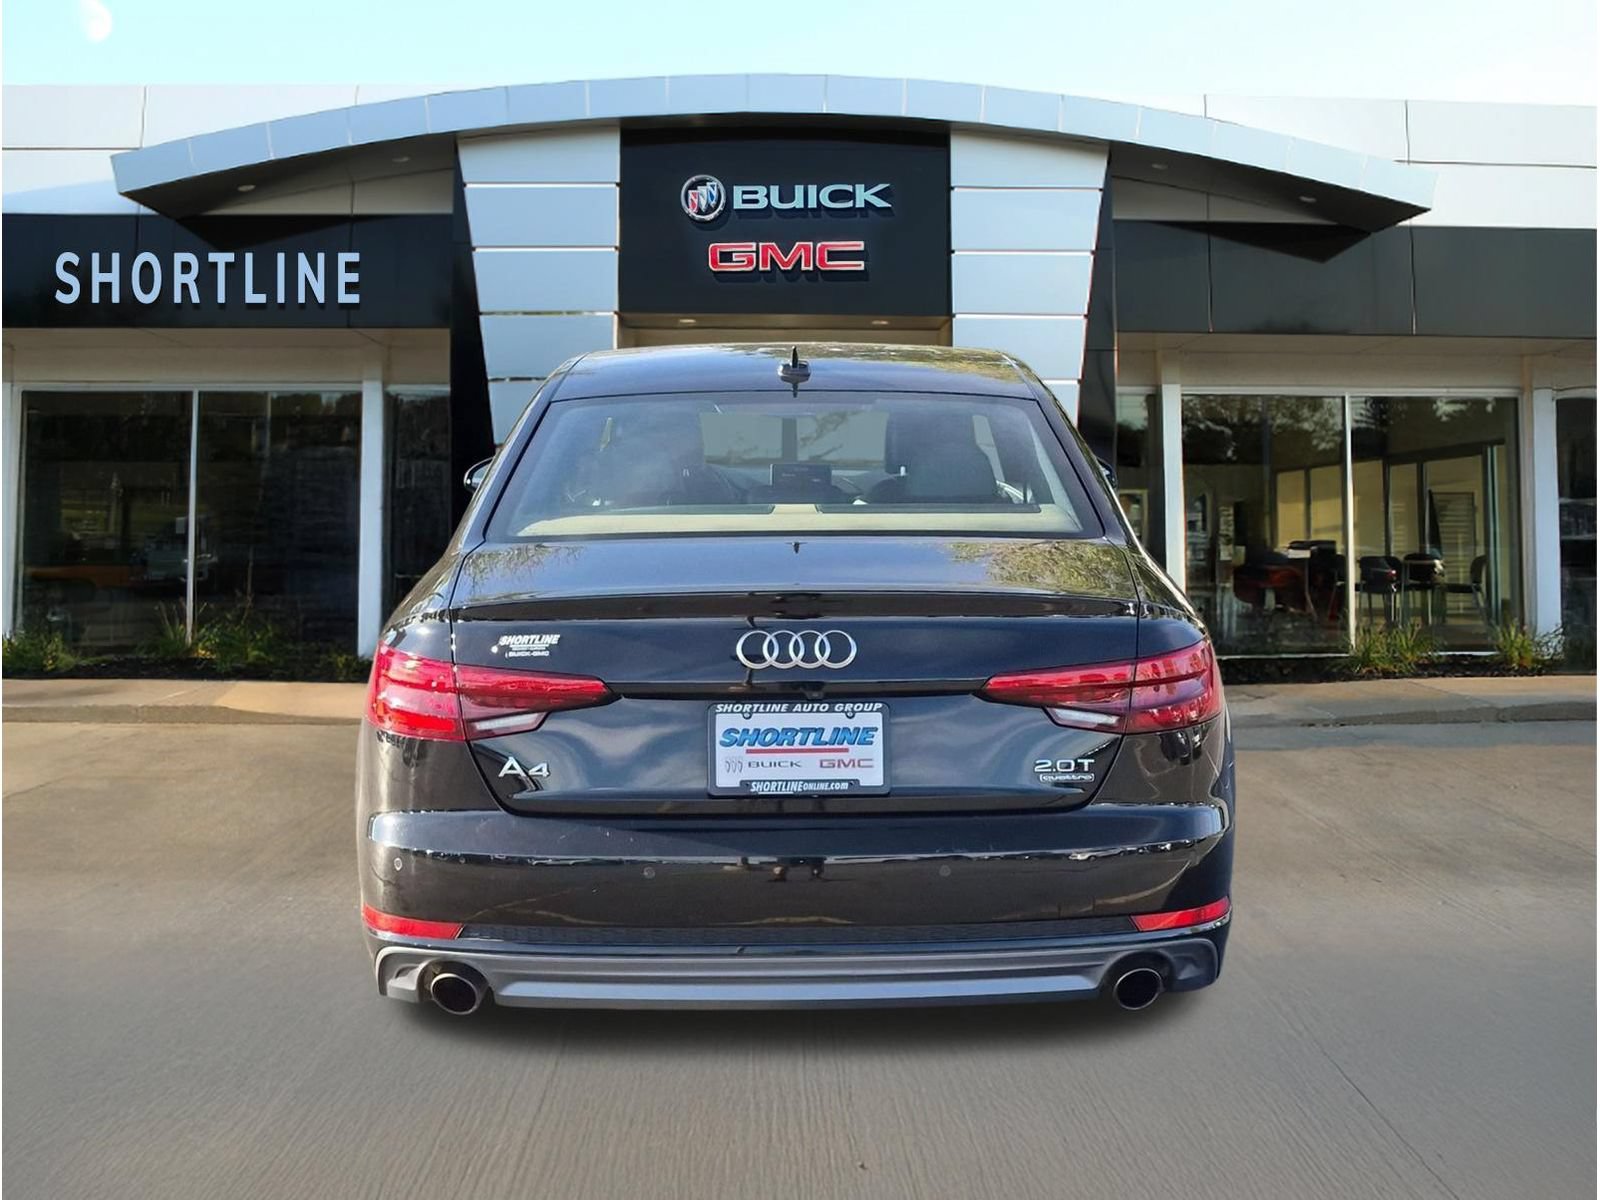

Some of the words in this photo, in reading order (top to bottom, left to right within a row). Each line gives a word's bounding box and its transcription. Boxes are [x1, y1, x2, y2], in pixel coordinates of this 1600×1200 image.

[733, 184, 892, 210] BUICK
[708, 241, 865, 272] GMC
[55, 252, 360, 304] SHORTLINE
[499, 634, 561, 646] SHORTLINE
[715, 704, 789, 713] SHORTLINE
[793, 704, 830, 712] AUTO
[834, 703, 883, 712] GROUP
[719, 727, 879, 747] SHORTLINE
[748, 761, 802, 769] BUICK
[819, 758, 875, 769] GMC
[1034, 759, 1095, 772] 2.0T
